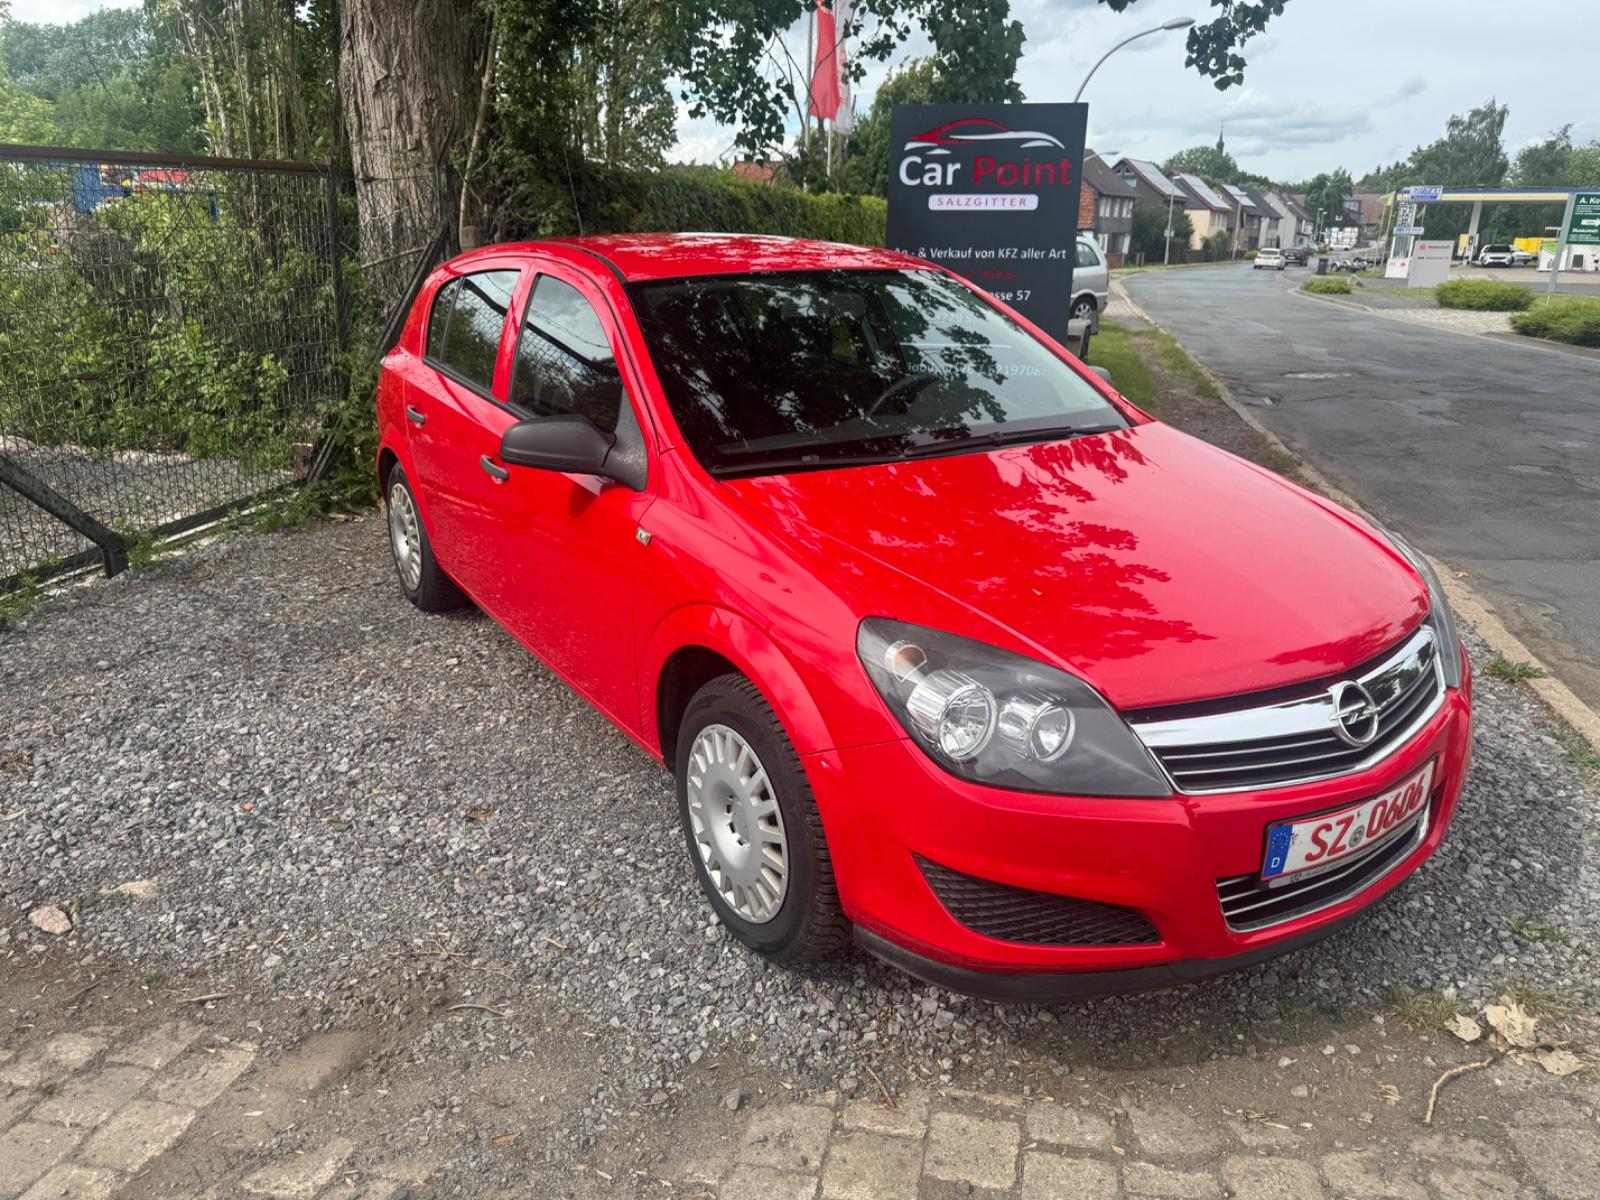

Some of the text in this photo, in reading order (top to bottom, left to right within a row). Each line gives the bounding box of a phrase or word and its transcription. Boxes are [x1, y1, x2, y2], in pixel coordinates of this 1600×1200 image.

[899, 155, 1073, 186] Car Point
[937, 197, 1027, 207] SALZGITTER
[918, 247, 927, 258] &
[930, 246, 972, 259] Verkauf
[975, 250, 995, 259] von
[998, 247, 1018, 259] KFZ
[1021, 247, 1046, 259] aller
[1049, 248, 1067, 259] Art
[1017, 289, 1031, 301] 57
[1304, 773, 1425, 861] SZ 0606
[1271, 857, 1280, 868] D
